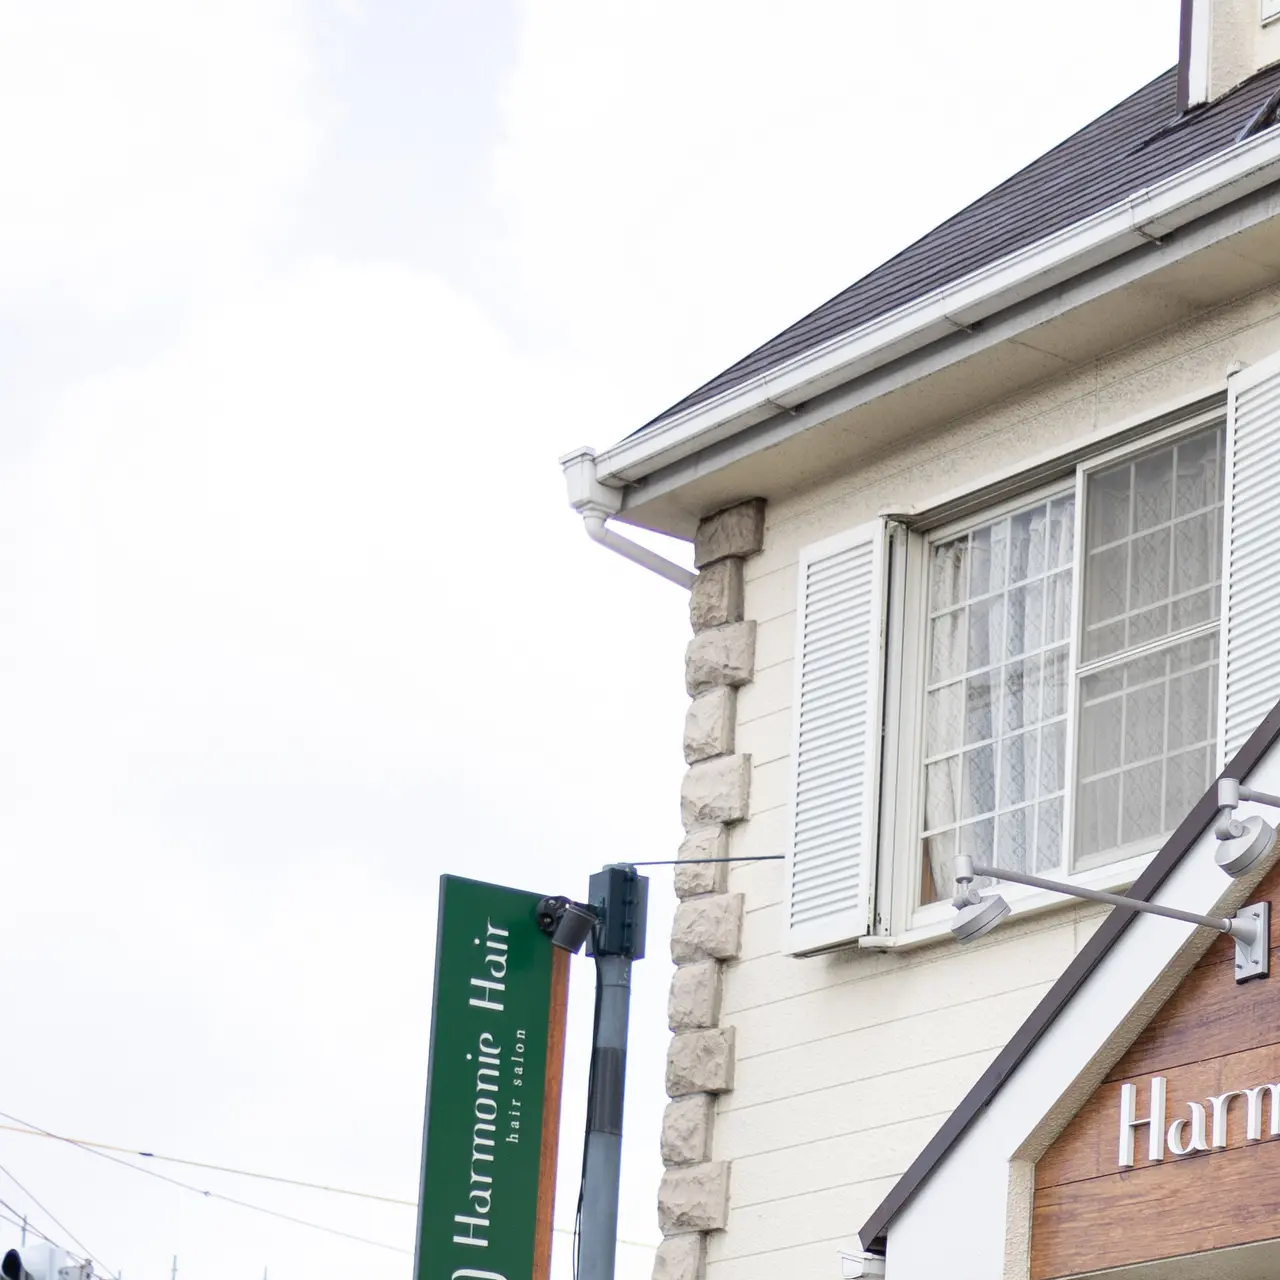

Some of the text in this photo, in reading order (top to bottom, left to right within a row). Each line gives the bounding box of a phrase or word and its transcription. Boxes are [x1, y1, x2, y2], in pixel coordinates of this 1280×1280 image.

[453, 917, 510, 1247] Harmonic Hair
[506, 1028, 527, 1144] hair salon
